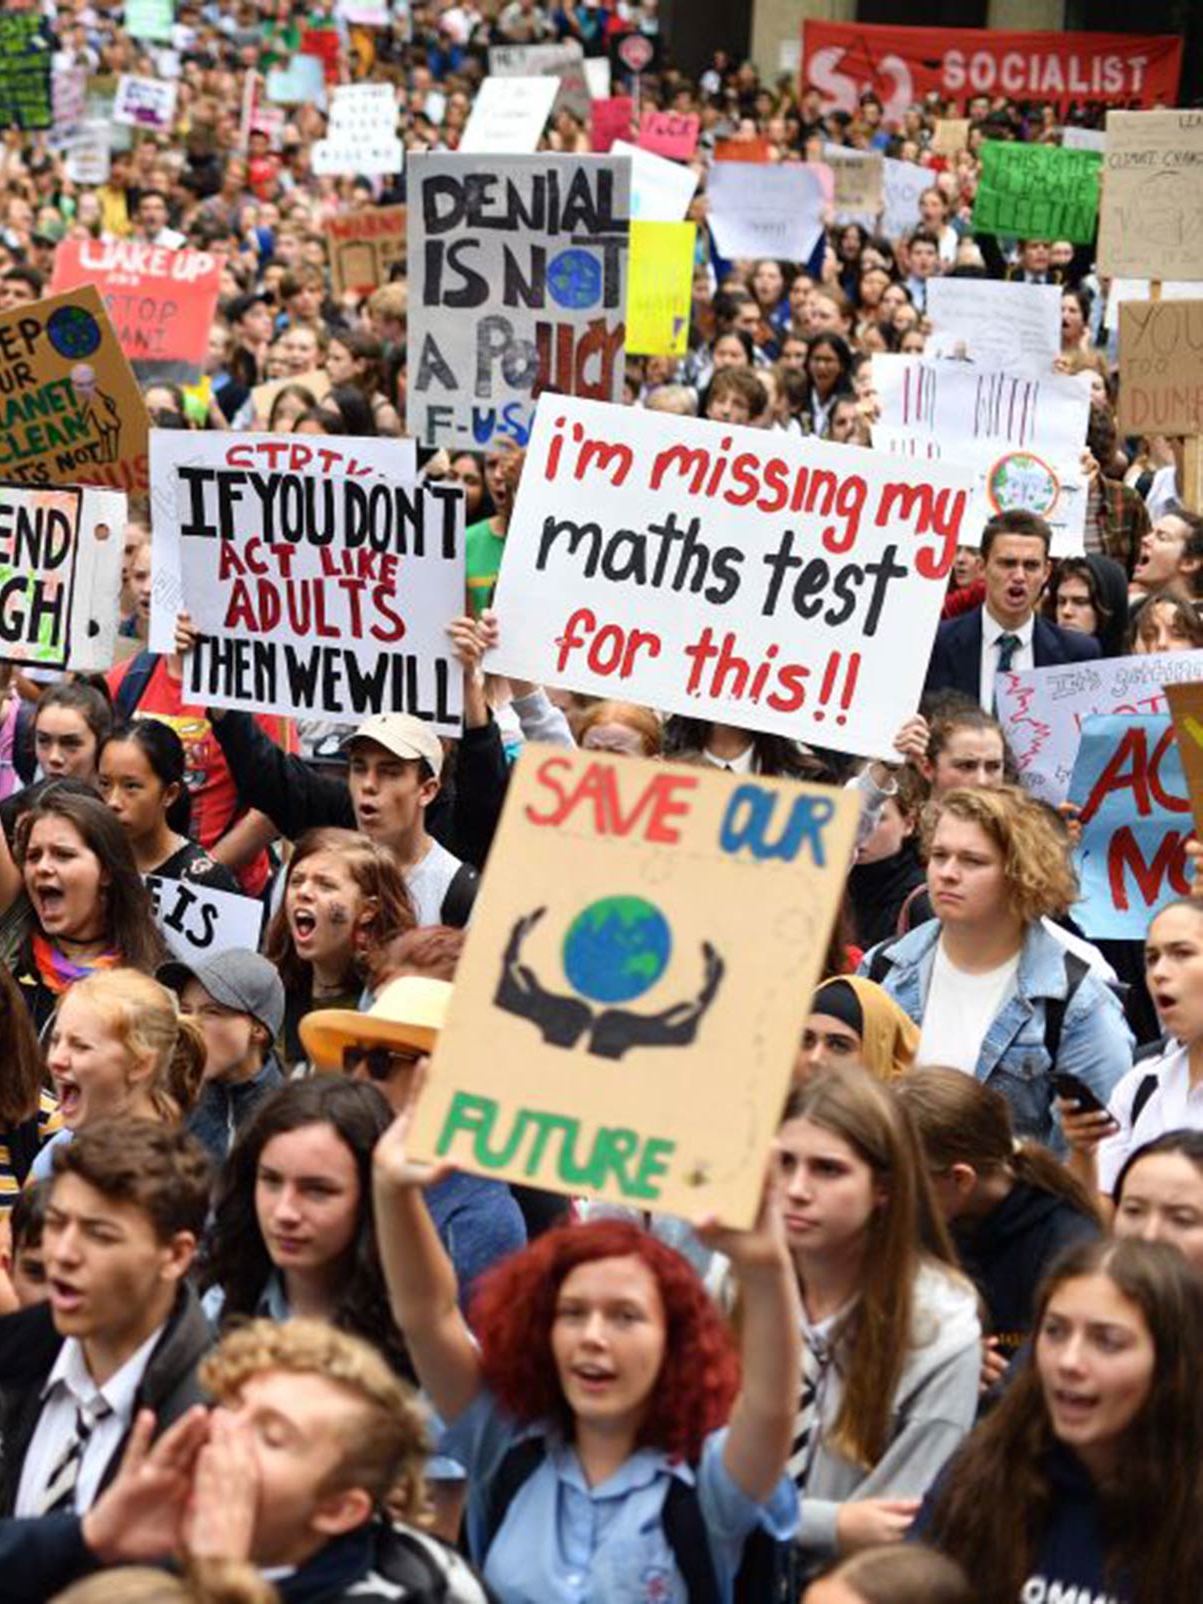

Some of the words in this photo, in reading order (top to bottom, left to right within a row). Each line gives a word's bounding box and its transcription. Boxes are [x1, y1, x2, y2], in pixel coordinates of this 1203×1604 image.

[941, 49, 1148, 93] SOCIALIST
[421, 165, 630, 237] DENIAL
[79, 239, 169, 279] WAKE
[170, 249, 216, 283] UP
[423, 238, 490, 309] IS
[502, 235, 630, 311] NOT
[414, 332, 459, 391] A
[474, 314, 626, 400] POLICY
[54, 441, 100, 474] NOT
[178, 466, 248, 540] IF
[251, 471, 336, 547] YOU
[543, 415, 634, 487] i'm
[648, 435, 868, 554] missing
[873, 481, 968, 580] my
[218, 536, 297, 581] ACT
[319, 546, 401, 590] LIKE
[535, 512, 746, 606] maths
[761, 529, 909, 638] test
[223, 577, 407, 643] ADULTS
[190, 633, 278, 704] THEN
[284, 644, 344, 714] WE
[343, 649, 461, 725] WILL
[554, 607, 662, 680] for
[684, 626, 862, 727] this!!
[523, 756, 698, 845] SAVE
[718, 782, 836, 868] OUR
[163, 884, 219, 949] IS
[435, 1091, 677, 1201] FUTURE
